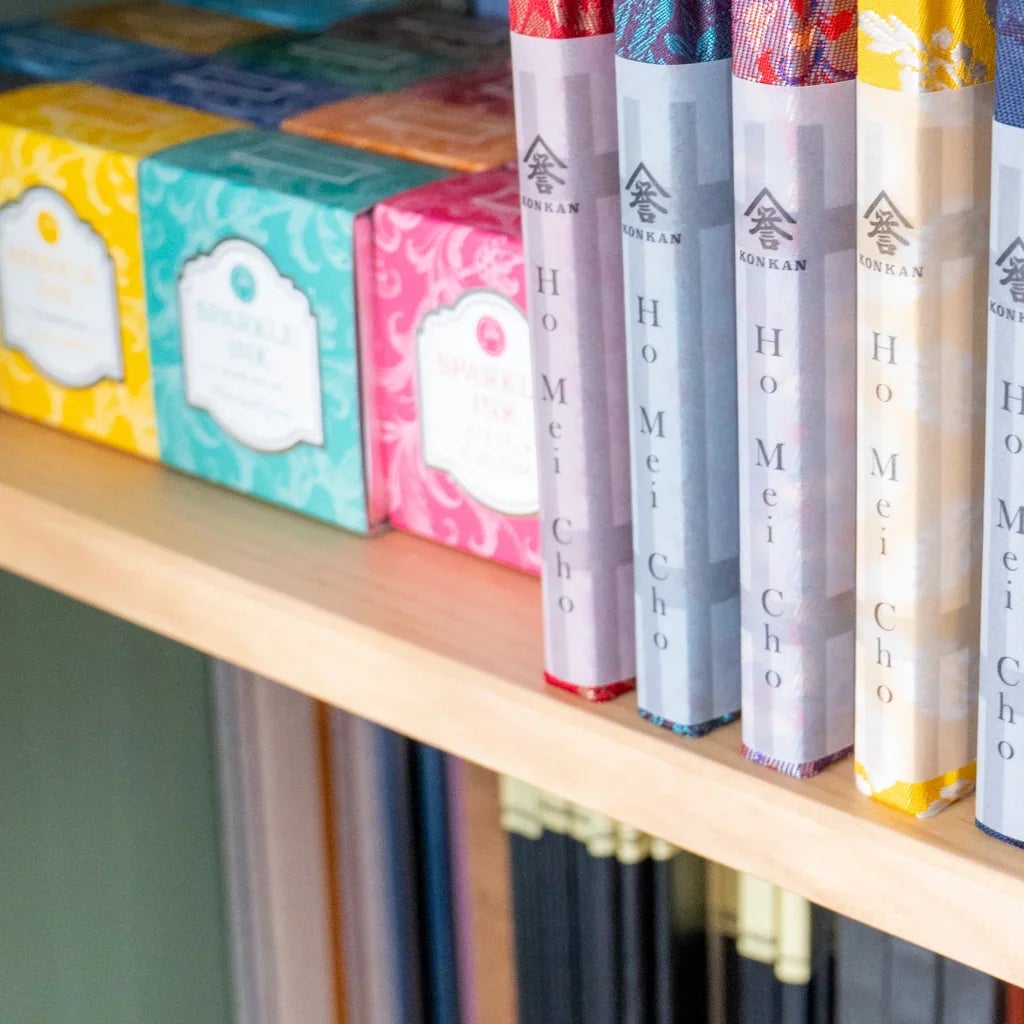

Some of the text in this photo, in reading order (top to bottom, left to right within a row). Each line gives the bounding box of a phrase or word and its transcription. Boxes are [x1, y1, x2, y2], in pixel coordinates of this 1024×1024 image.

[521, 195, 580, 215] KONKAN
[622, 224, 682, 245] KONKAN
[739, 250, 808, 272] KONKAN
[858, 253, 924, 278] KONKAN
[437, 352, 532, 400] SPARKL
[536, 265, 575, 613] Ho Mei Cho
[636, 295, 669, 650] Ho Mei Cho
[755, 324, 785, 689] Ho Mei Cho
[870, 331, 899, 704] Ho Mei Cho
[996, 656, 1020, 760] Cho
